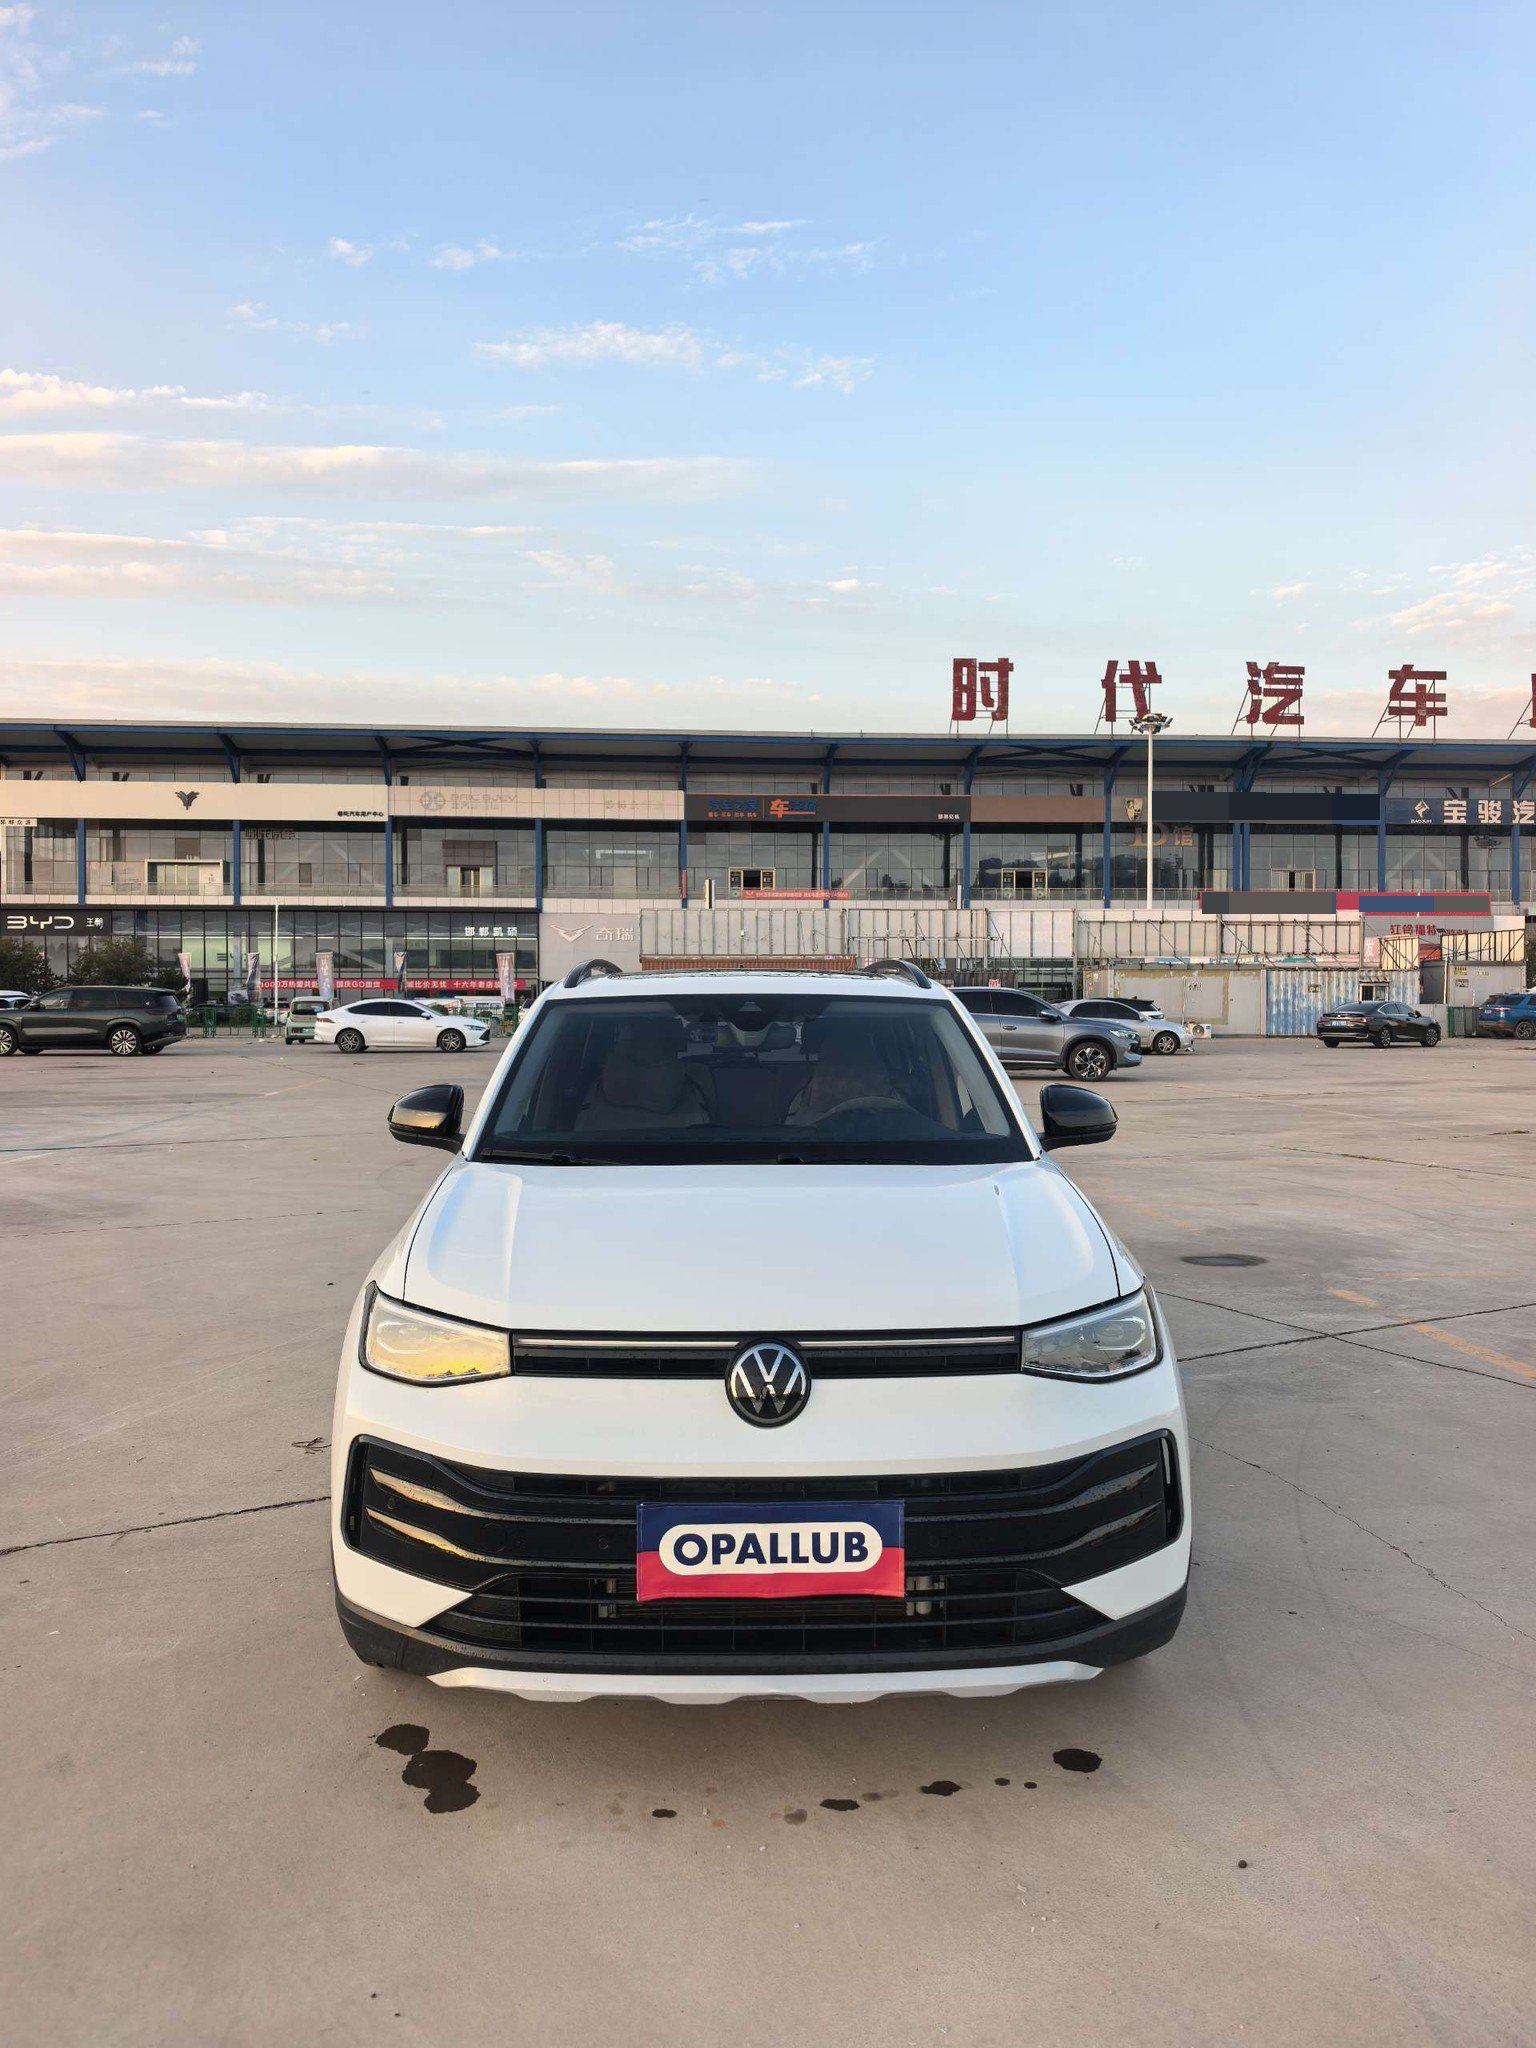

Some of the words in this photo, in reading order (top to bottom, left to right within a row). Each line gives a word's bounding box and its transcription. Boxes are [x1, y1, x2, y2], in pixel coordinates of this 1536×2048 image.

[952, 658, 1536, 729] 时代汽车
[7, 915, 75, 930] BYD
[673, 1531, 869, 1566] OPALLUB
